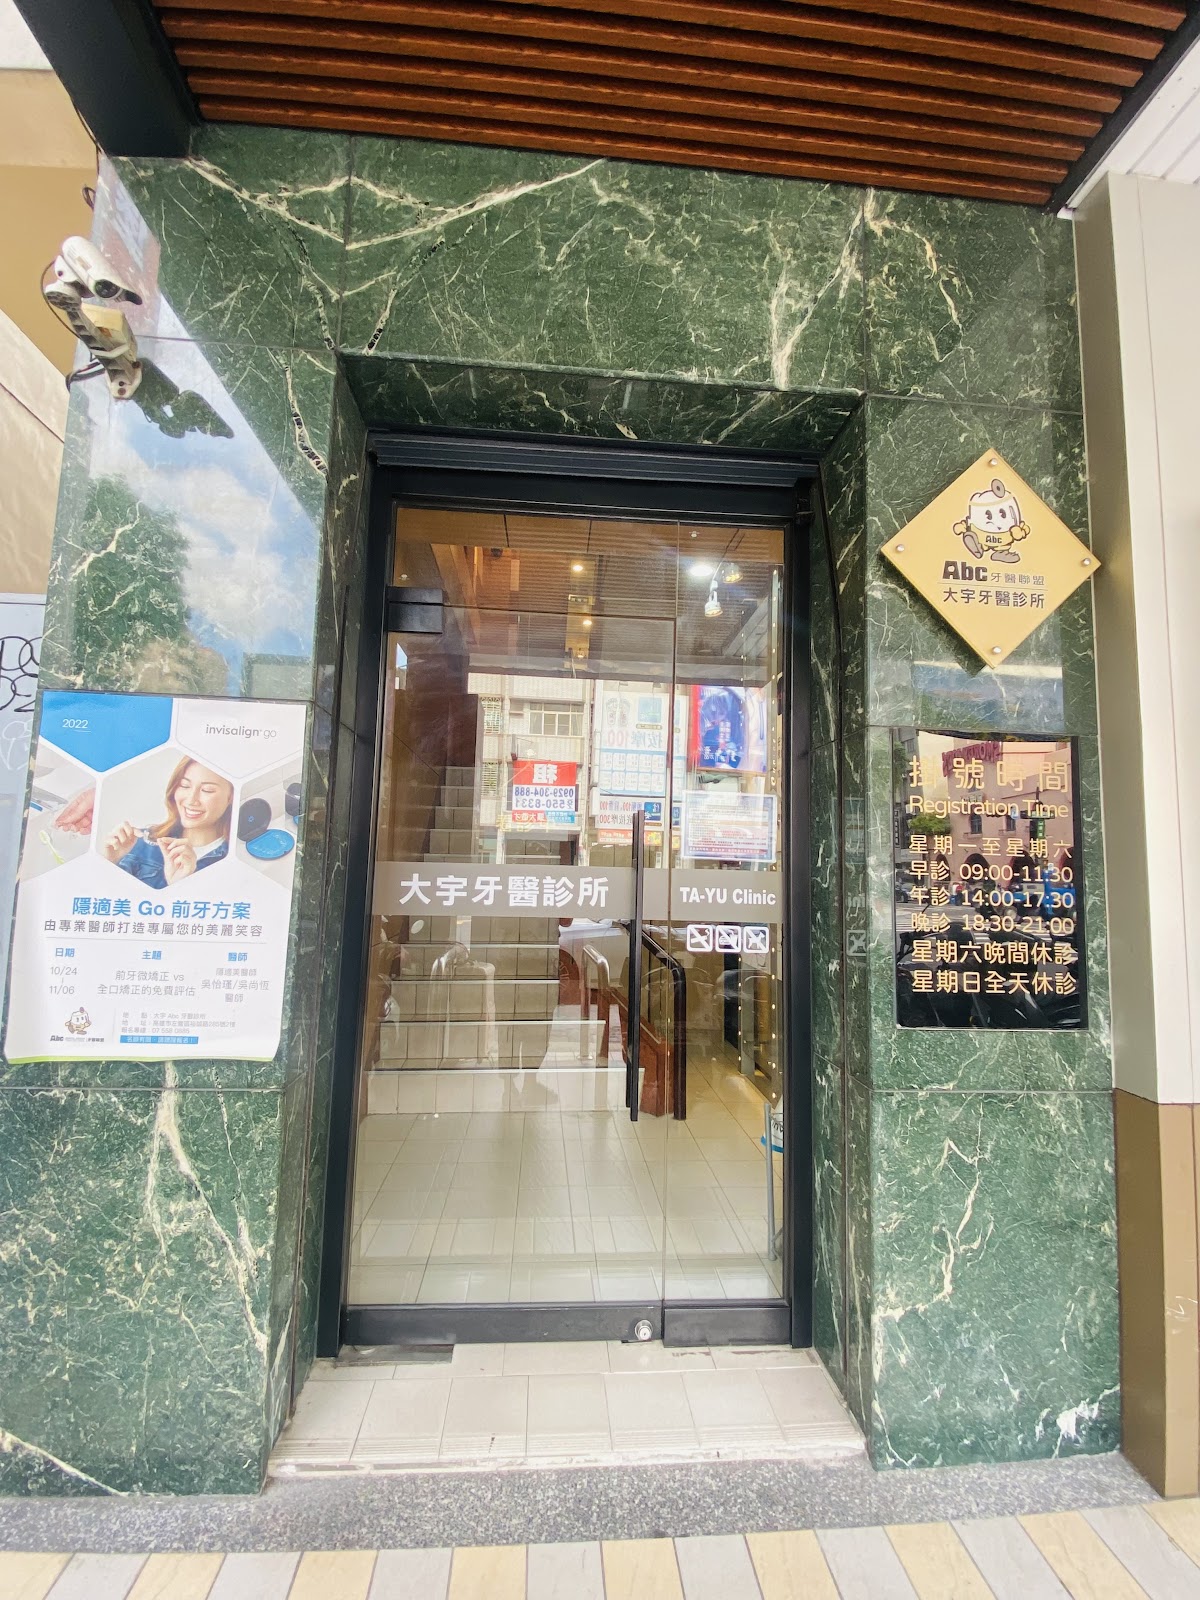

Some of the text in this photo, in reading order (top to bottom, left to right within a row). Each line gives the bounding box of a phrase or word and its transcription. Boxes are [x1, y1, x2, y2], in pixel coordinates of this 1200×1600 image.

[985, 534, 1003, 544] Abc
[942, 560, 1045, 586] Abc 牙醫聯盟
[943, 587, 1045, 609] 大宇牙醫診所
[62, 718, 89, 730] 2022
[263, 728, 277, 739] go
[908, 754, 1069, 793] 掛號時間
[909, 794, 1069, 819] Registration Time
[908, 834, 1073, 859] 星期一至星期六
[909, 860, 1073, 883] 早診 09:00-11:30
[398, 873, 609, 909] 大宇牙醫診所
[679, 885, 777, 906] TA-YU Clinic
[909, 885, 1074, 909] 午診 14:00-17:30
[72, 896, 252, 920] 隱適美 Go 前牙方案
[44, 919, 263, 937] 由專業醫師打造專屬您的美麗笑容
[910, 911, 1075, 935] 晚診 18:30-21:00
[54, 947, 75, 958] 日期
[142, 950, 162, 961] 主題
[911, 939, 1079, 966] 星期六晚間休診
[50, 966, 78, 976] 10/24
[173, 973, 185, 982] vs
[911, 969, 1077, 995] 星期日全天休診
[49, 984, 75, 995] 11/06
